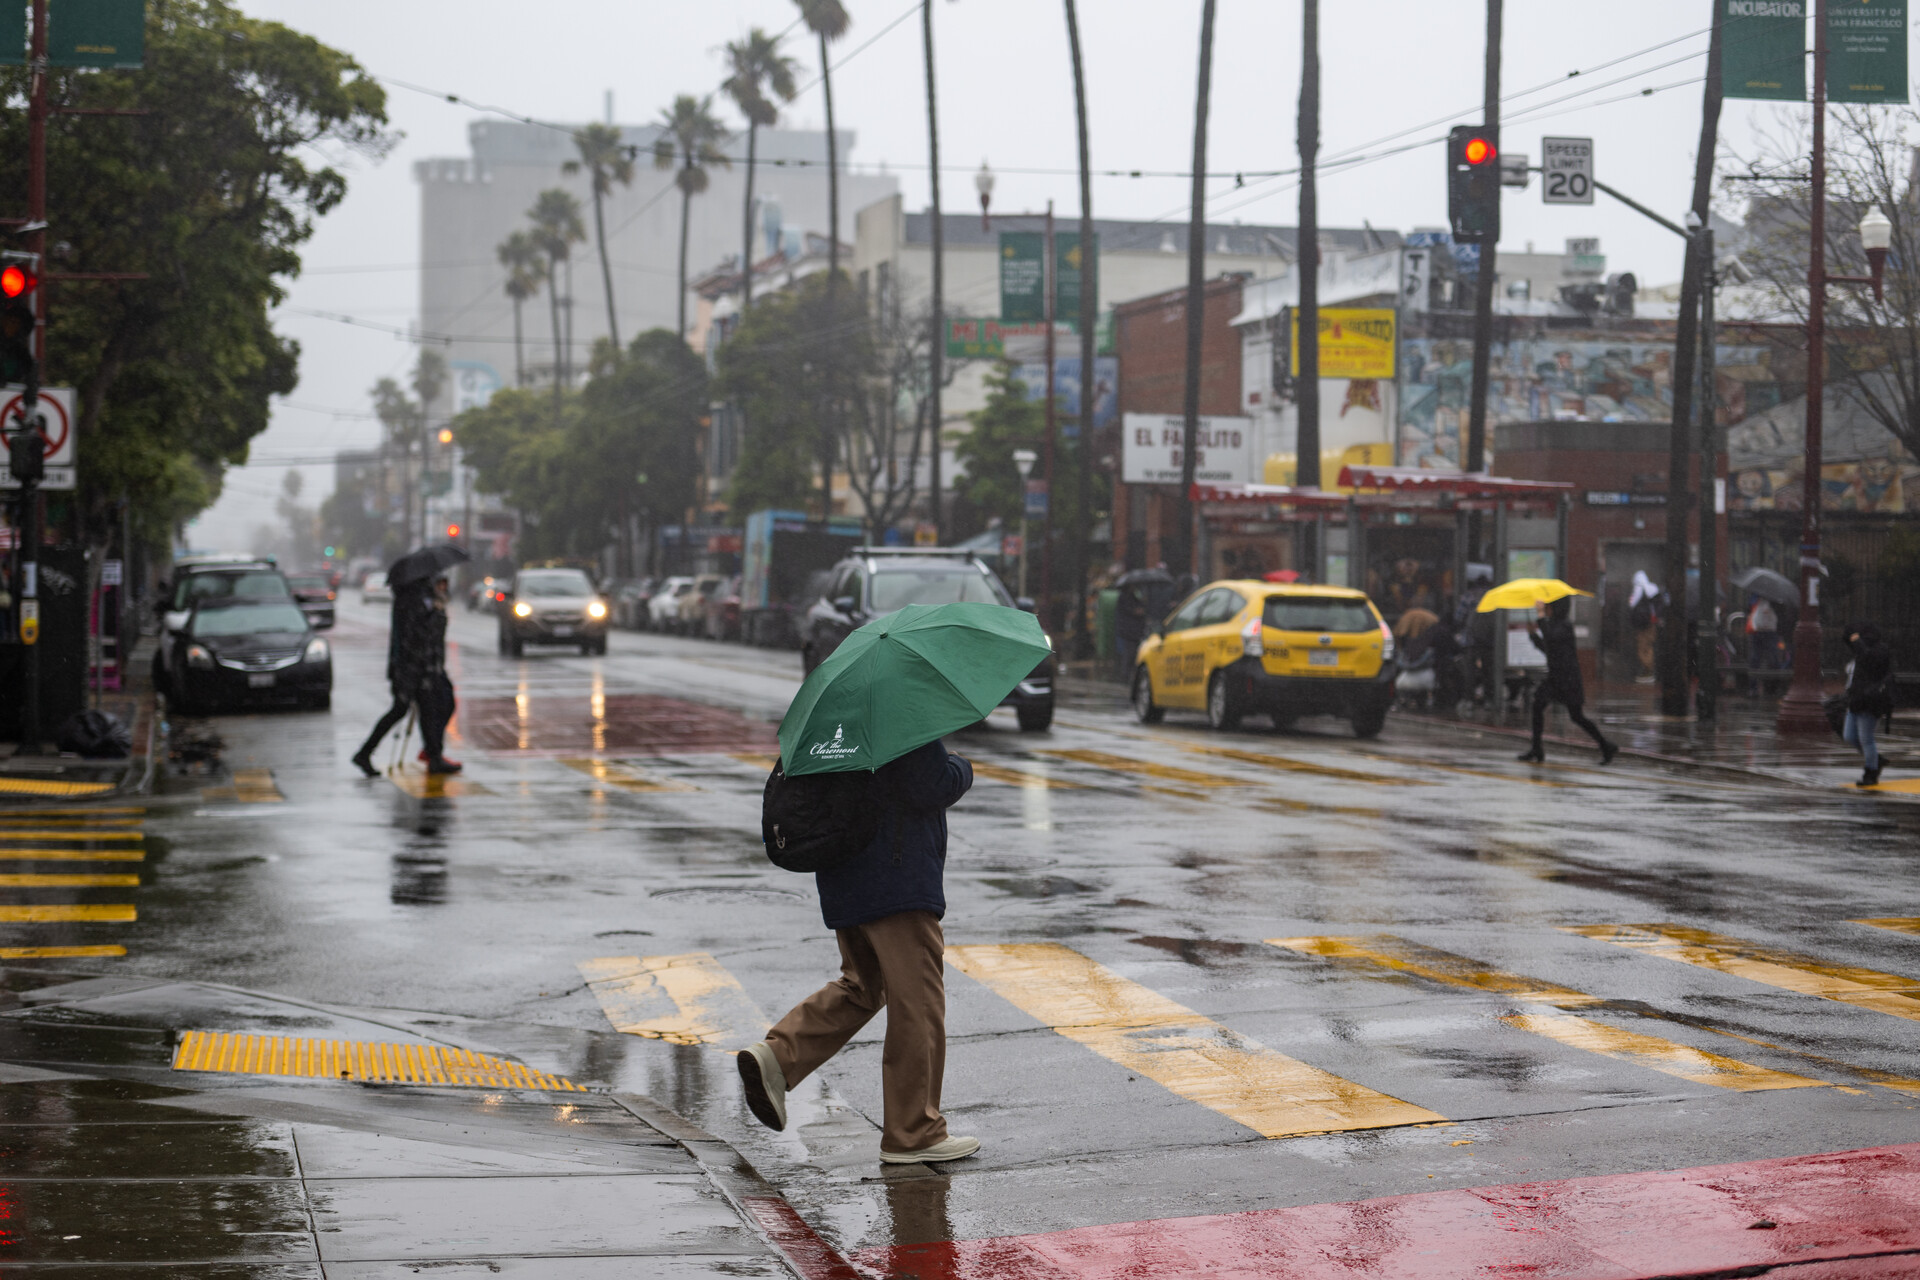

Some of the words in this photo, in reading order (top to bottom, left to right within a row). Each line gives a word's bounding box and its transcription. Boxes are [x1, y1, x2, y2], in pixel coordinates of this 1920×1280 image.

[1828, 8, 1886, 17] UNIVERSITY
[1889, 8, 1902, 17] OF
[1828, 18, 1848, 28] SAN
[1850, 18, 1903, 28] FRANCISCO
[1547, 144, 1589, 157] SPEED
[1551, 159, 1585, 170] LIMIT
[1548, 173, 1588, 198] 20
[1136, 427, 1155, 446] EL
[1162, 429, 1242, 448] FAOLITO
[1171, 450, 1205, 467] BR
[809, 742, 860, 756] Claremont
[830, 737, 845, 749] the
